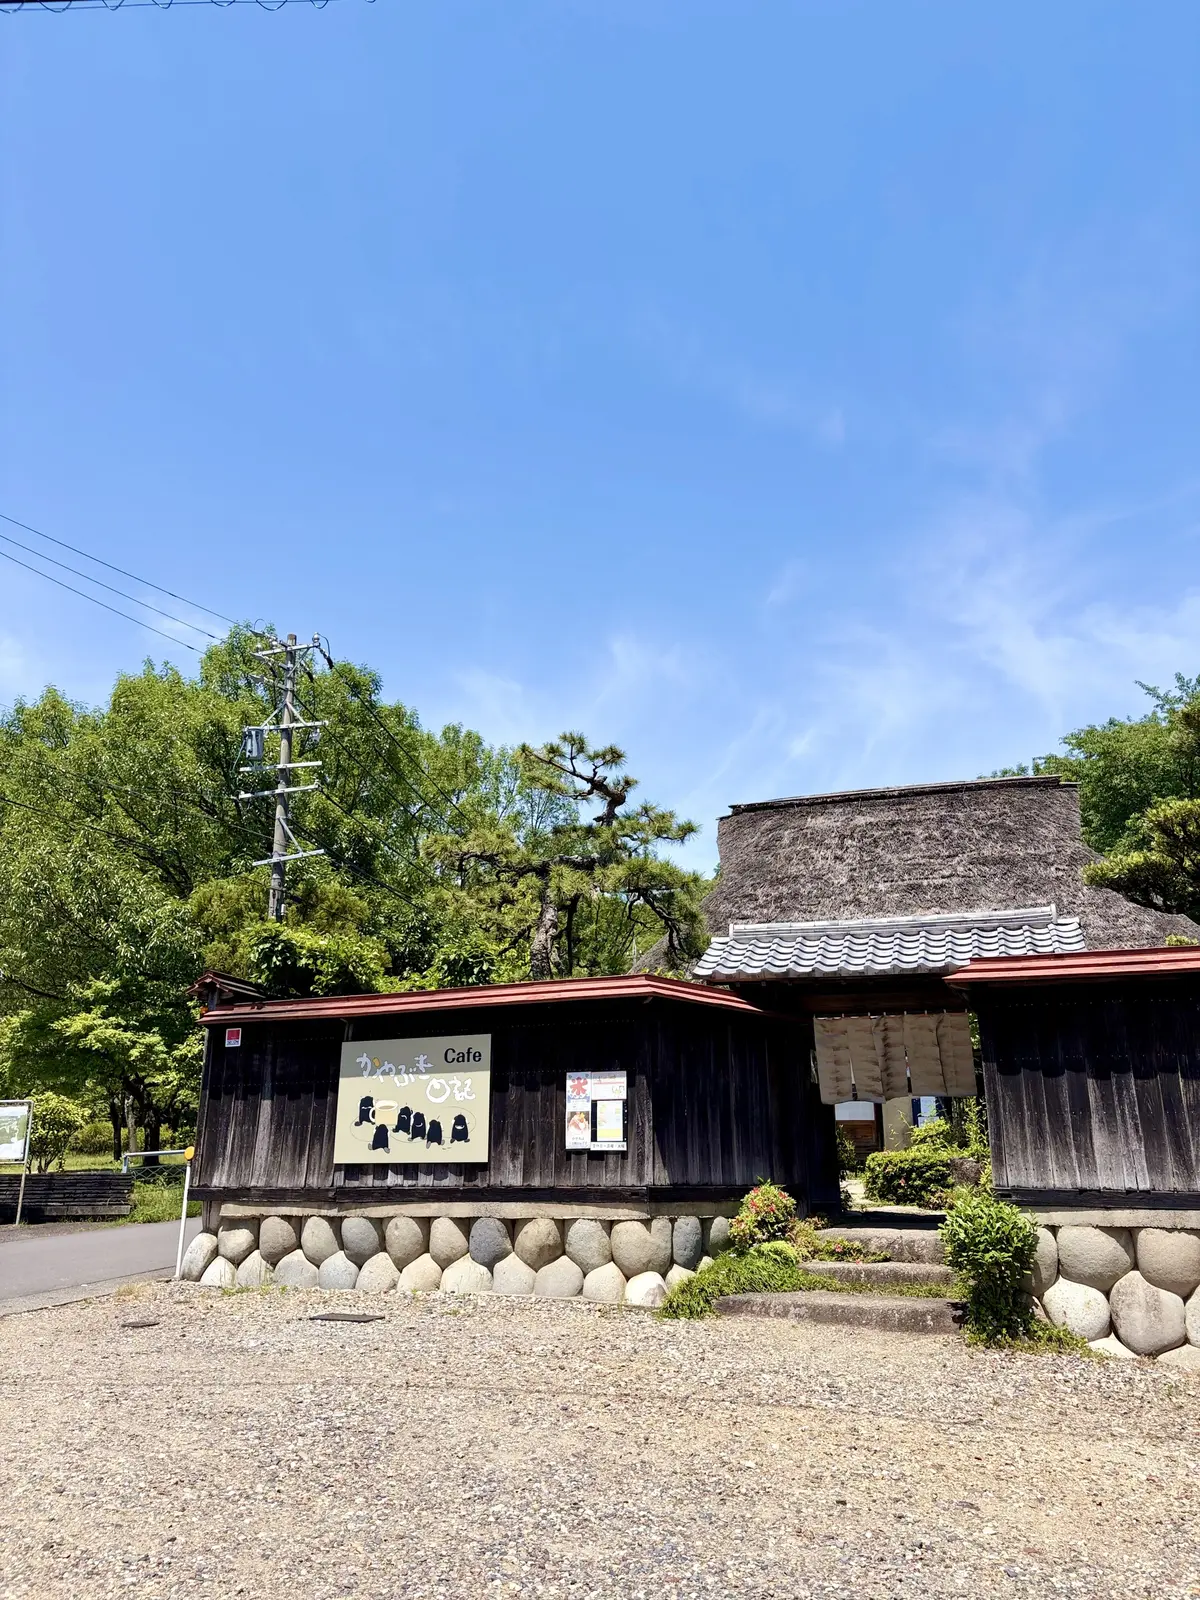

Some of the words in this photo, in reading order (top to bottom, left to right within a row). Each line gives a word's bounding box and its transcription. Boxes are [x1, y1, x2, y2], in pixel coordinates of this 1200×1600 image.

[444, 1047, 482, 1063] Cafe
[356, 1052, 434, 1087] かやぶき
[426, 1076, 476, 1103] 日記
